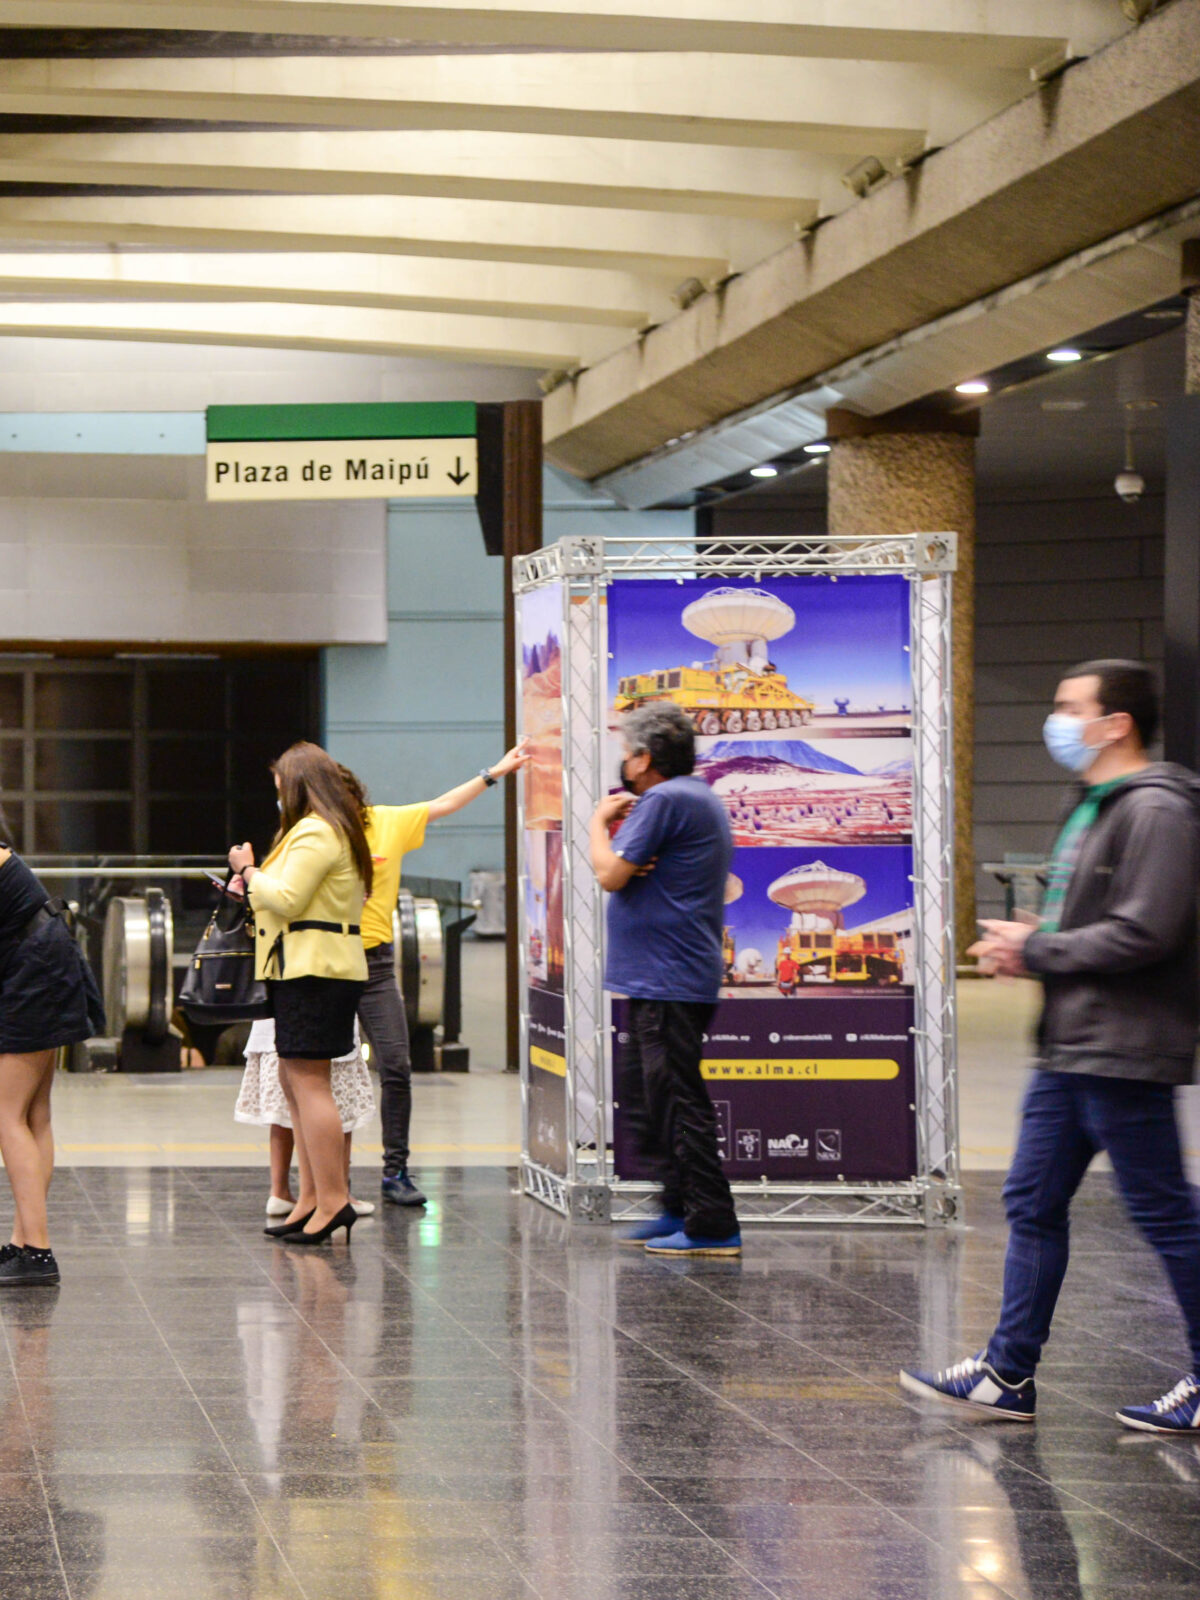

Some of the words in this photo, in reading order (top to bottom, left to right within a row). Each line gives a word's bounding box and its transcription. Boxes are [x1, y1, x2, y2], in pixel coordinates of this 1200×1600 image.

[215, 462, 289, 483] Plaza
[302, 460, 332, 482] de
[345, 458, 429, 484] Maipú
[708, 1064, 818, 1074] www.alma.cl
